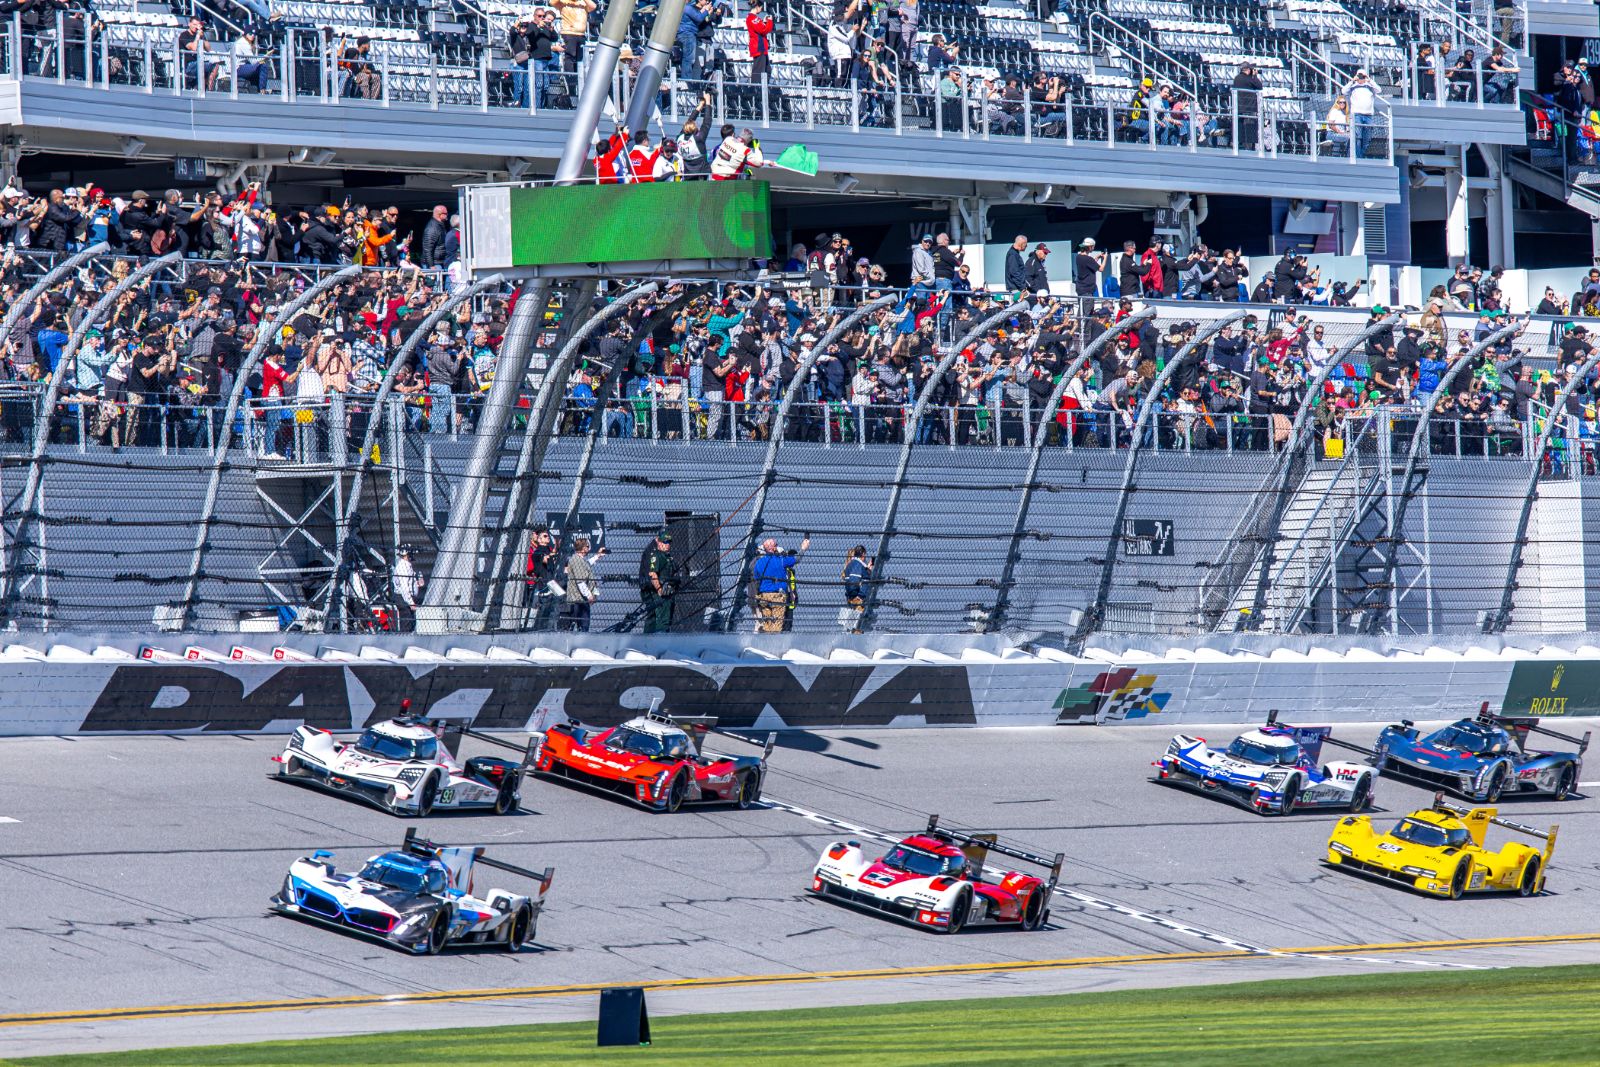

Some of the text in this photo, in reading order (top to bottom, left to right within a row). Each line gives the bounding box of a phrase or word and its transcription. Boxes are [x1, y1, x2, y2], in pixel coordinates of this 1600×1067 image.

[178, 158, 187, 175] 145
[782, 280, 811, 288] WHELEN
[79, 665, 976, 732] DAYTONA
[1528, 698, 1568, 714] ROLEX
[571, 748, 631, 772] WHELEN
[1336, 768, 1359, 781] HRC
[441, 790, 453, 803] 93
[1302, 791, 1313, 803] 60
